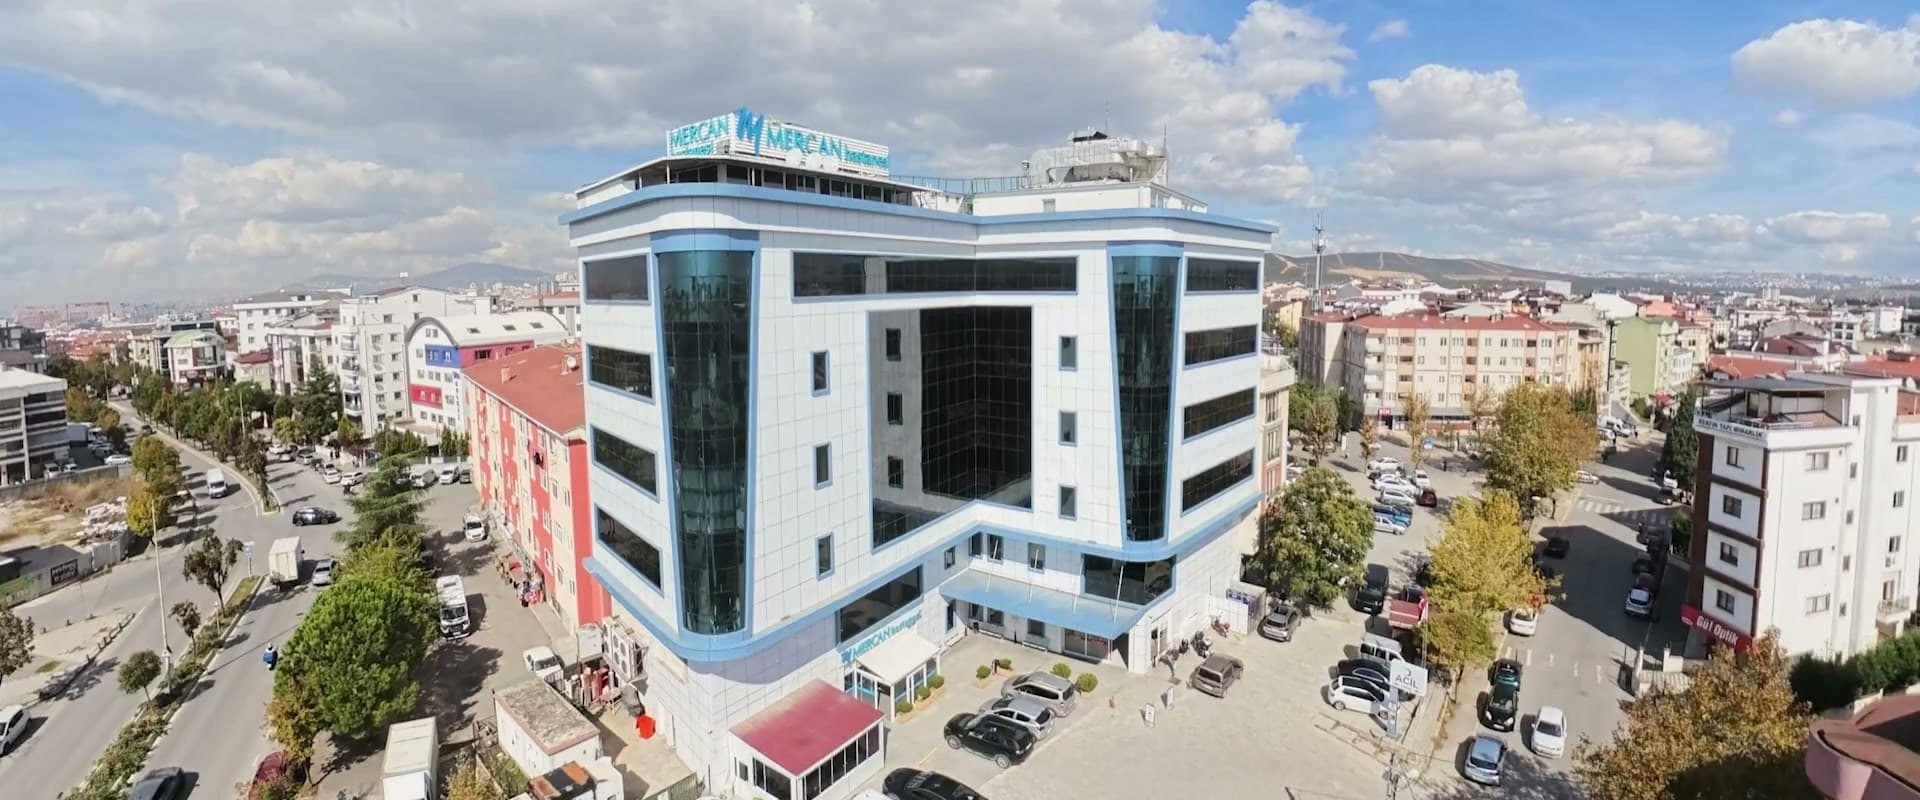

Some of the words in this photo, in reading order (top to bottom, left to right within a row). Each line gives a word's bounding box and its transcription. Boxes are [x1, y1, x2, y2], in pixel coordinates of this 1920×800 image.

[671, 118, 728, 147] MERCAN
[766, 125, 842, 159] MERCAN
[854, 628, 891, 657] MERCAN
[1697, 616, 1713, 632] Gül
[1714, 624, 1738, 646] Optik
